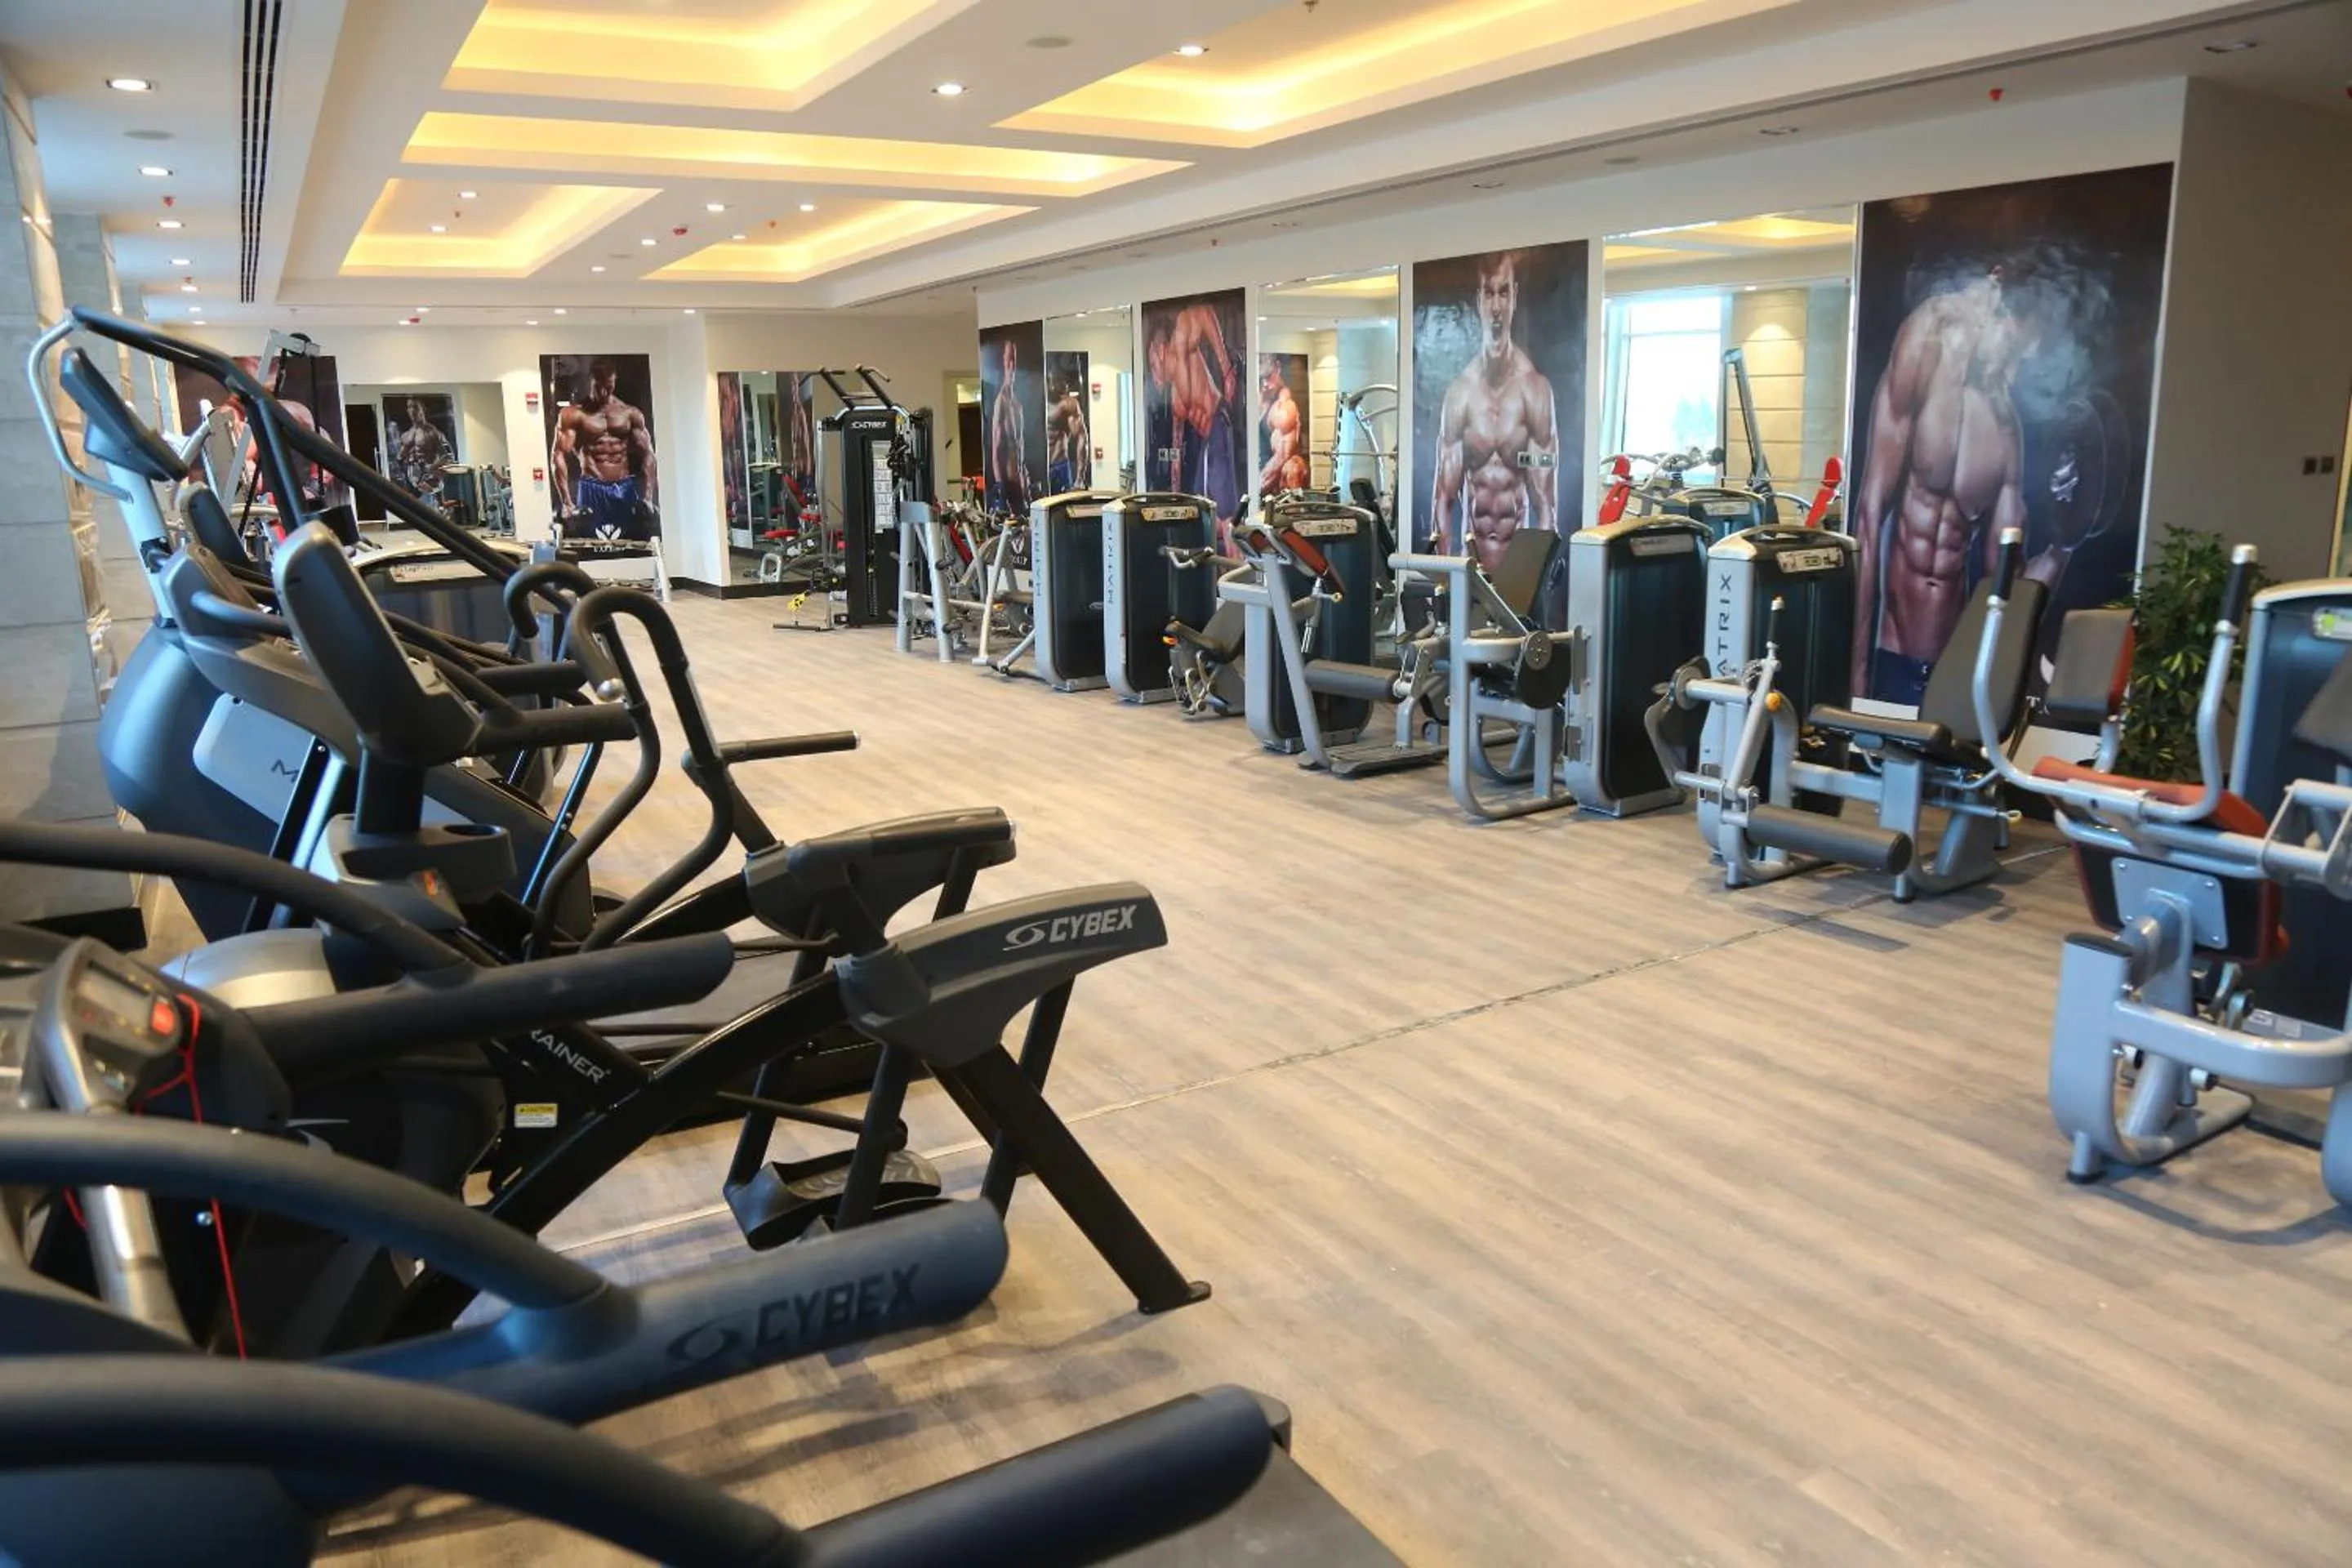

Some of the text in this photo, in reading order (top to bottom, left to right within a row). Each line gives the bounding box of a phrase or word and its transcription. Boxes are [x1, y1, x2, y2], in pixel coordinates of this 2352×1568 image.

[1717, 572, 1732, 677] ATRIX
[1049, 903, 1138, 944] CYBEX
[755, 1263, 921, 1349] CYBEX
